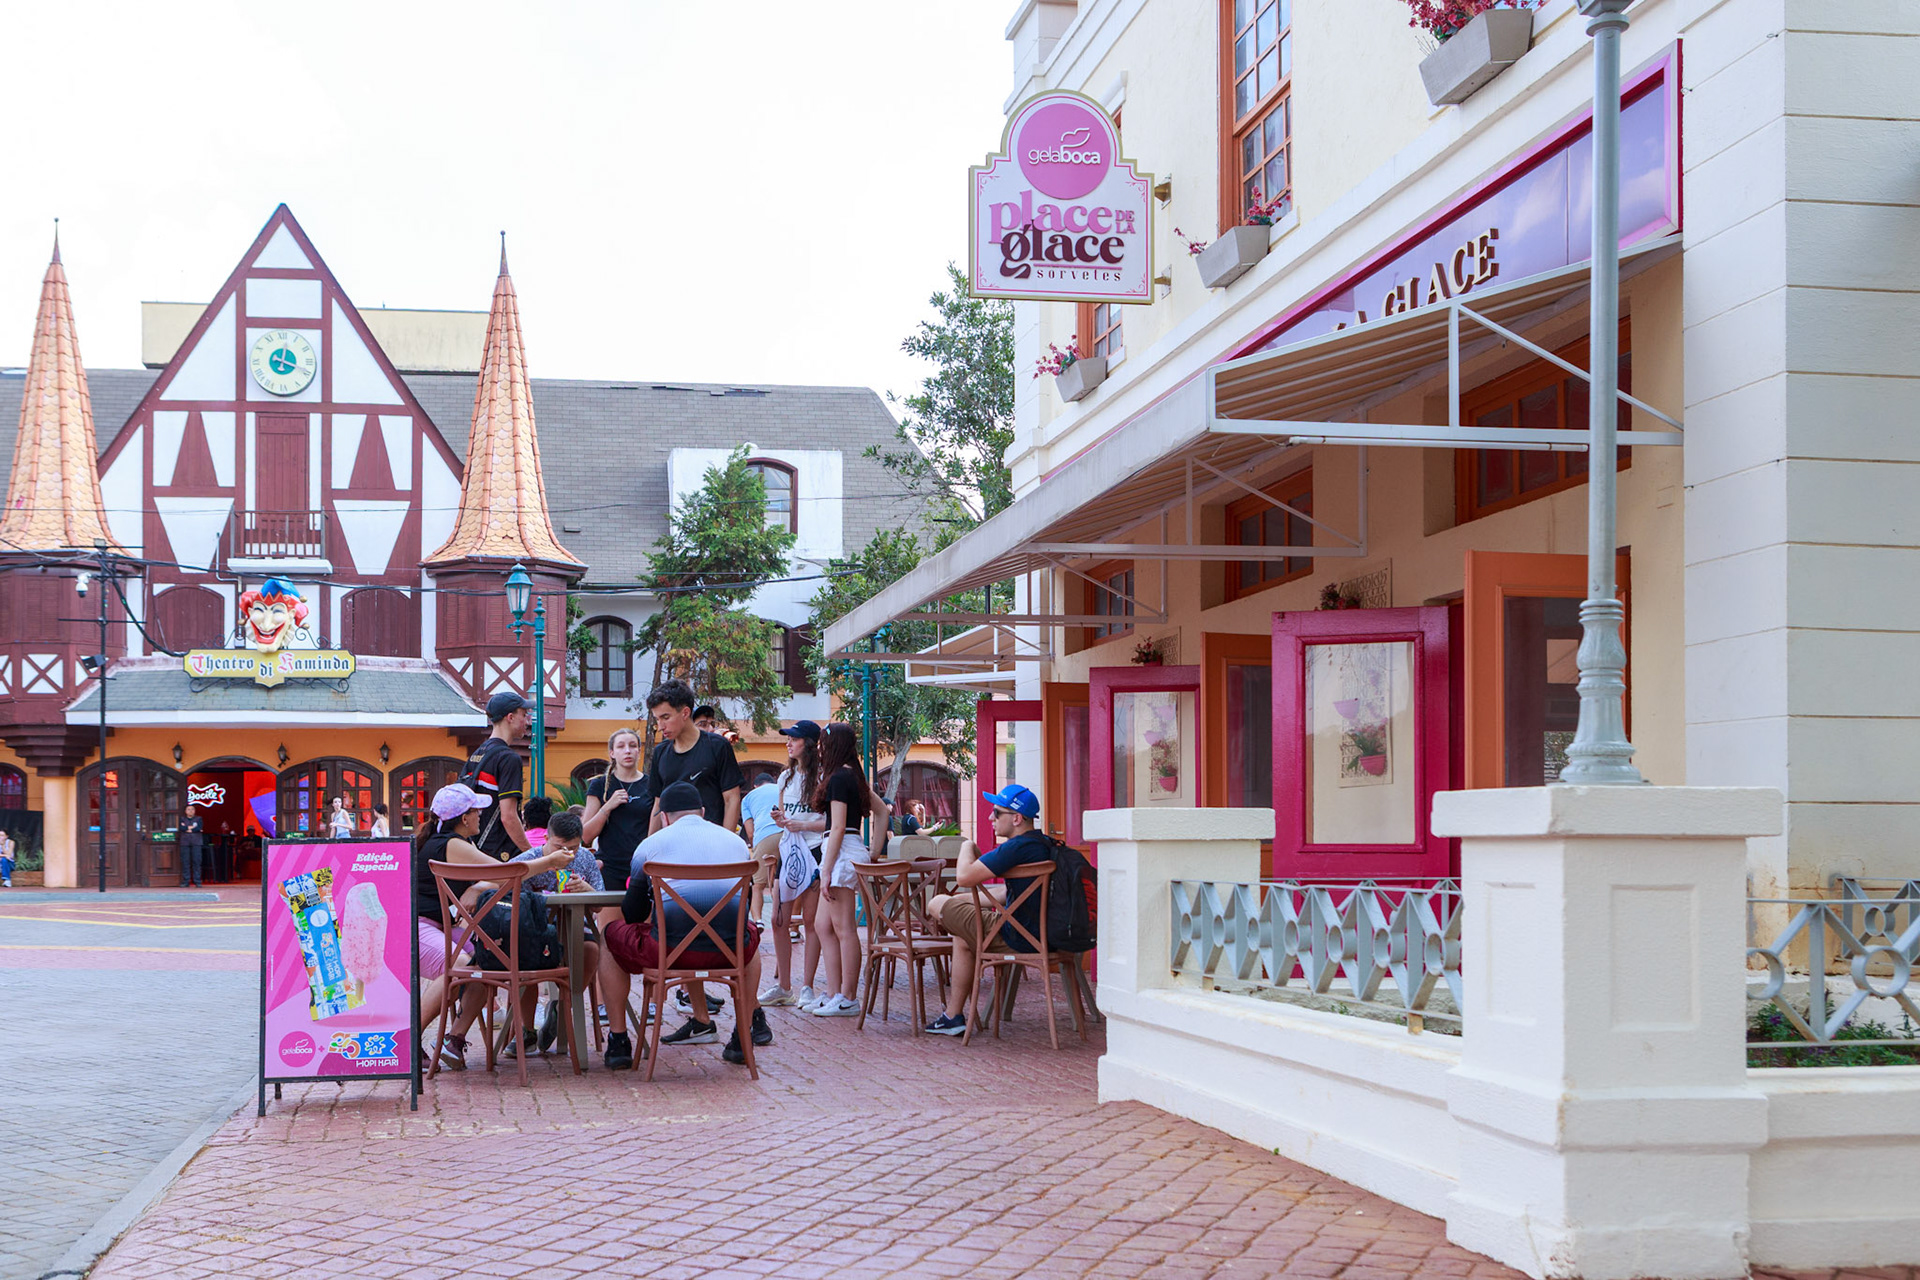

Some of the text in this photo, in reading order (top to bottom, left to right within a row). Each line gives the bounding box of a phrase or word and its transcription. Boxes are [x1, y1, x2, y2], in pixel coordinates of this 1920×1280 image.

[1028, 146, 1101, 165] gelaboca
[988, 189, 1135, 244] place DE
[1115, 222, 1136, 234] LA
[1000, 219, 1125, 279] glace
[1037, 269, 1121, 281] sorvetes
[190, 653, 254, 674] Theatro
[260, 662, 274, 677] di
[187, 788, 218, 802] Docile
[356, 852, 394, 863] Edição
[351, 861, 399, 873] Especial
[282, 1046, 313, 1056] gelaboca
[356, 1058, 399, 1068] HOPI HARI
